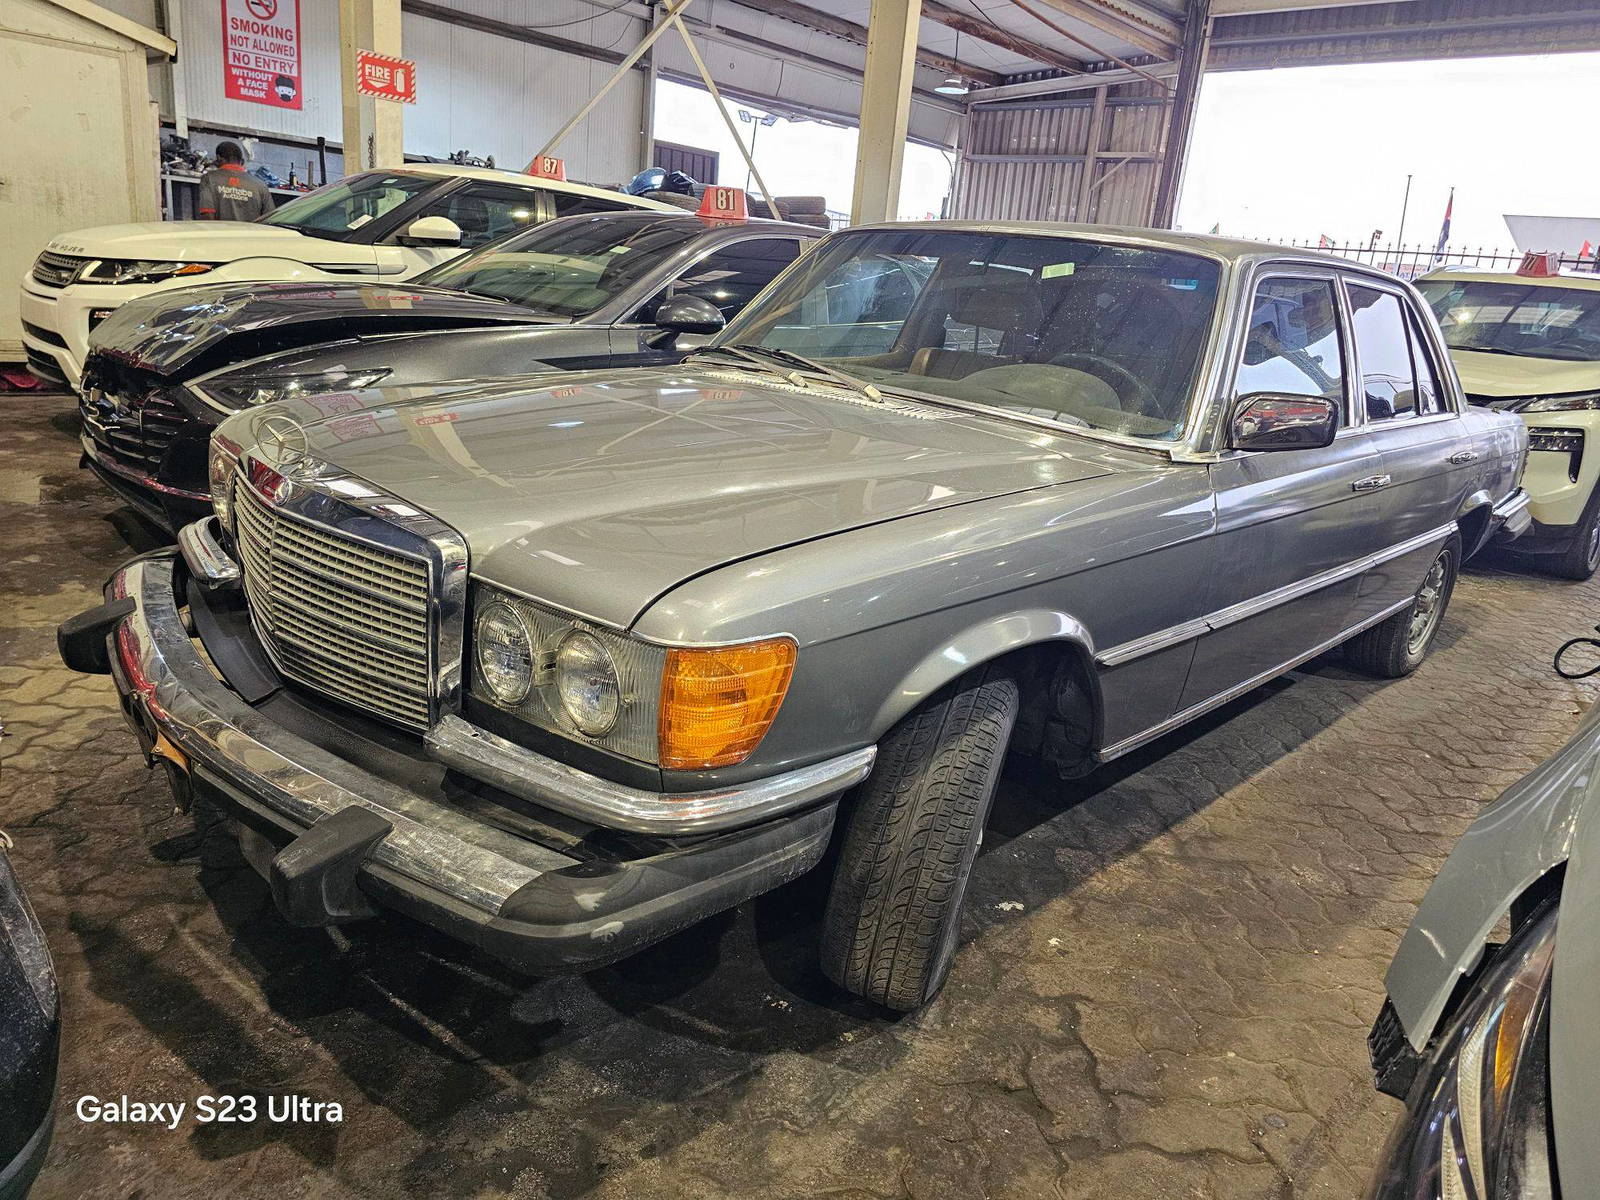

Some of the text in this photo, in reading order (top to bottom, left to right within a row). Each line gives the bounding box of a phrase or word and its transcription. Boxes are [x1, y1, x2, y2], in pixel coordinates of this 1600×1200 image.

[231, 17, 293, 41] SMOKING
[230, 34, 295, 57] NOT ALLOWED
[232, 52, 294, 74] NO ENTRY
[231, 68, 273, 81] WITHOUT
[365, 64, 391, 80] FIRE
[237, 78, 269, 90] A FACE
[240, 88, 266, 98] MASK
[543, 158, 557, 174] 87
[717, 189, 734, 210] 81
